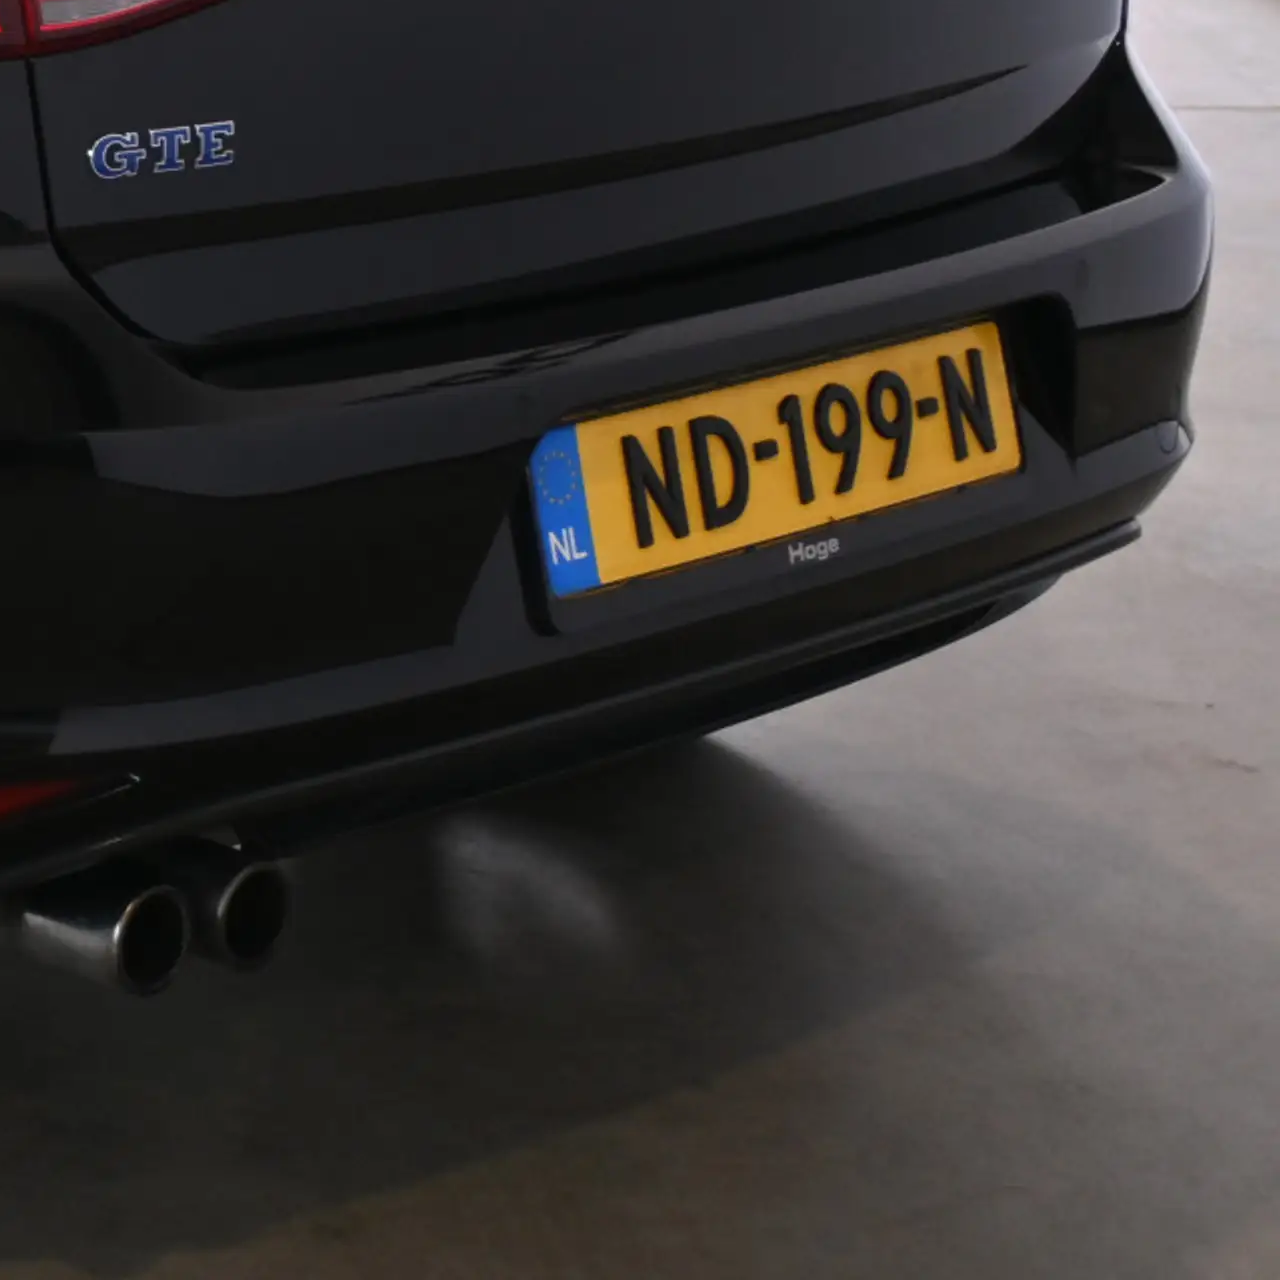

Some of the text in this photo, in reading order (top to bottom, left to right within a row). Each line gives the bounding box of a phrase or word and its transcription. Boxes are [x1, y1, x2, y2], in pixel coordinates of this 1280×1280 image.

[88, 120, 235, 178] GTE
[621, 347, 997, 549] ND-199-N
[548, 527, 588, 565] NL
[788, 537, 840, 564] Hoge
